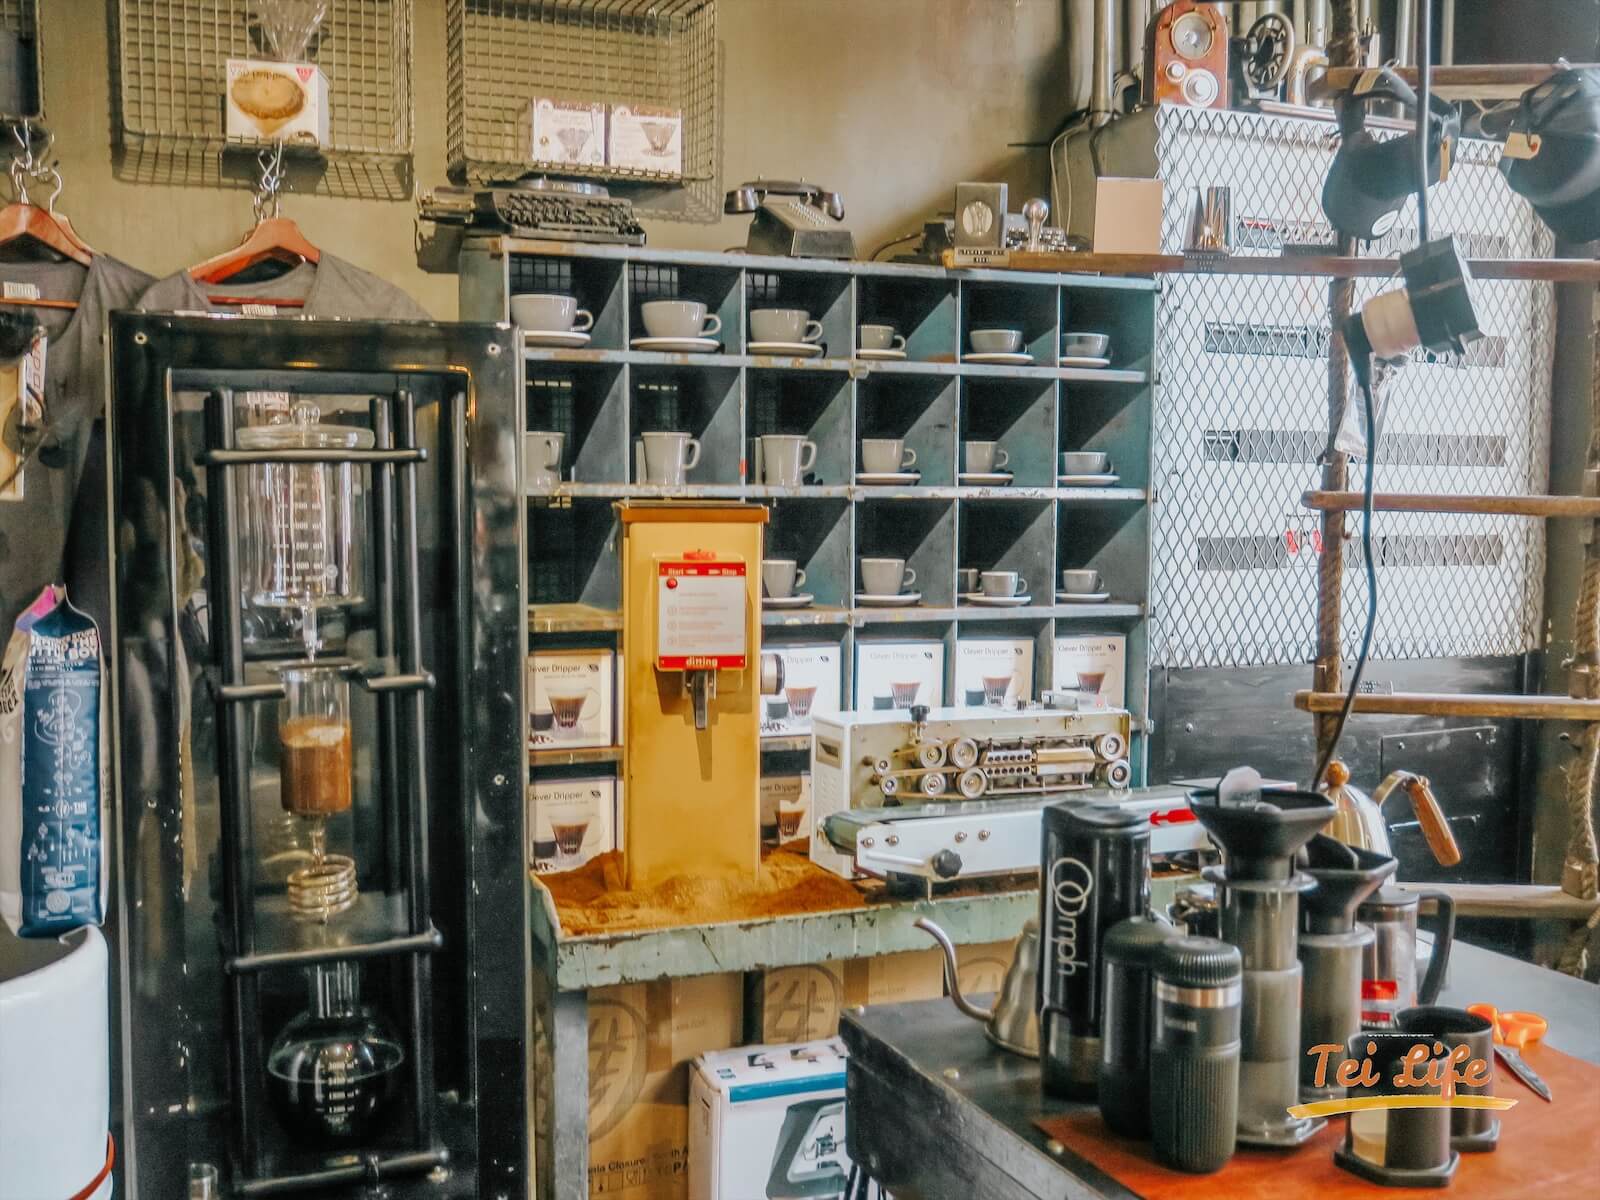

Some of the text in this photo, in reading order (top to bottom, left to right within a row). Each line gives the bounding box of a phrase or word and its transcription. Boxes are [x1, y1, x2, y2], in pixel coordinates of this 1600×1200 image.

[528, 663, 581, 674] lever Dripper
[553, 791, 583, 802] Dripper
[1050, 857, 1093, 976] Oomph
